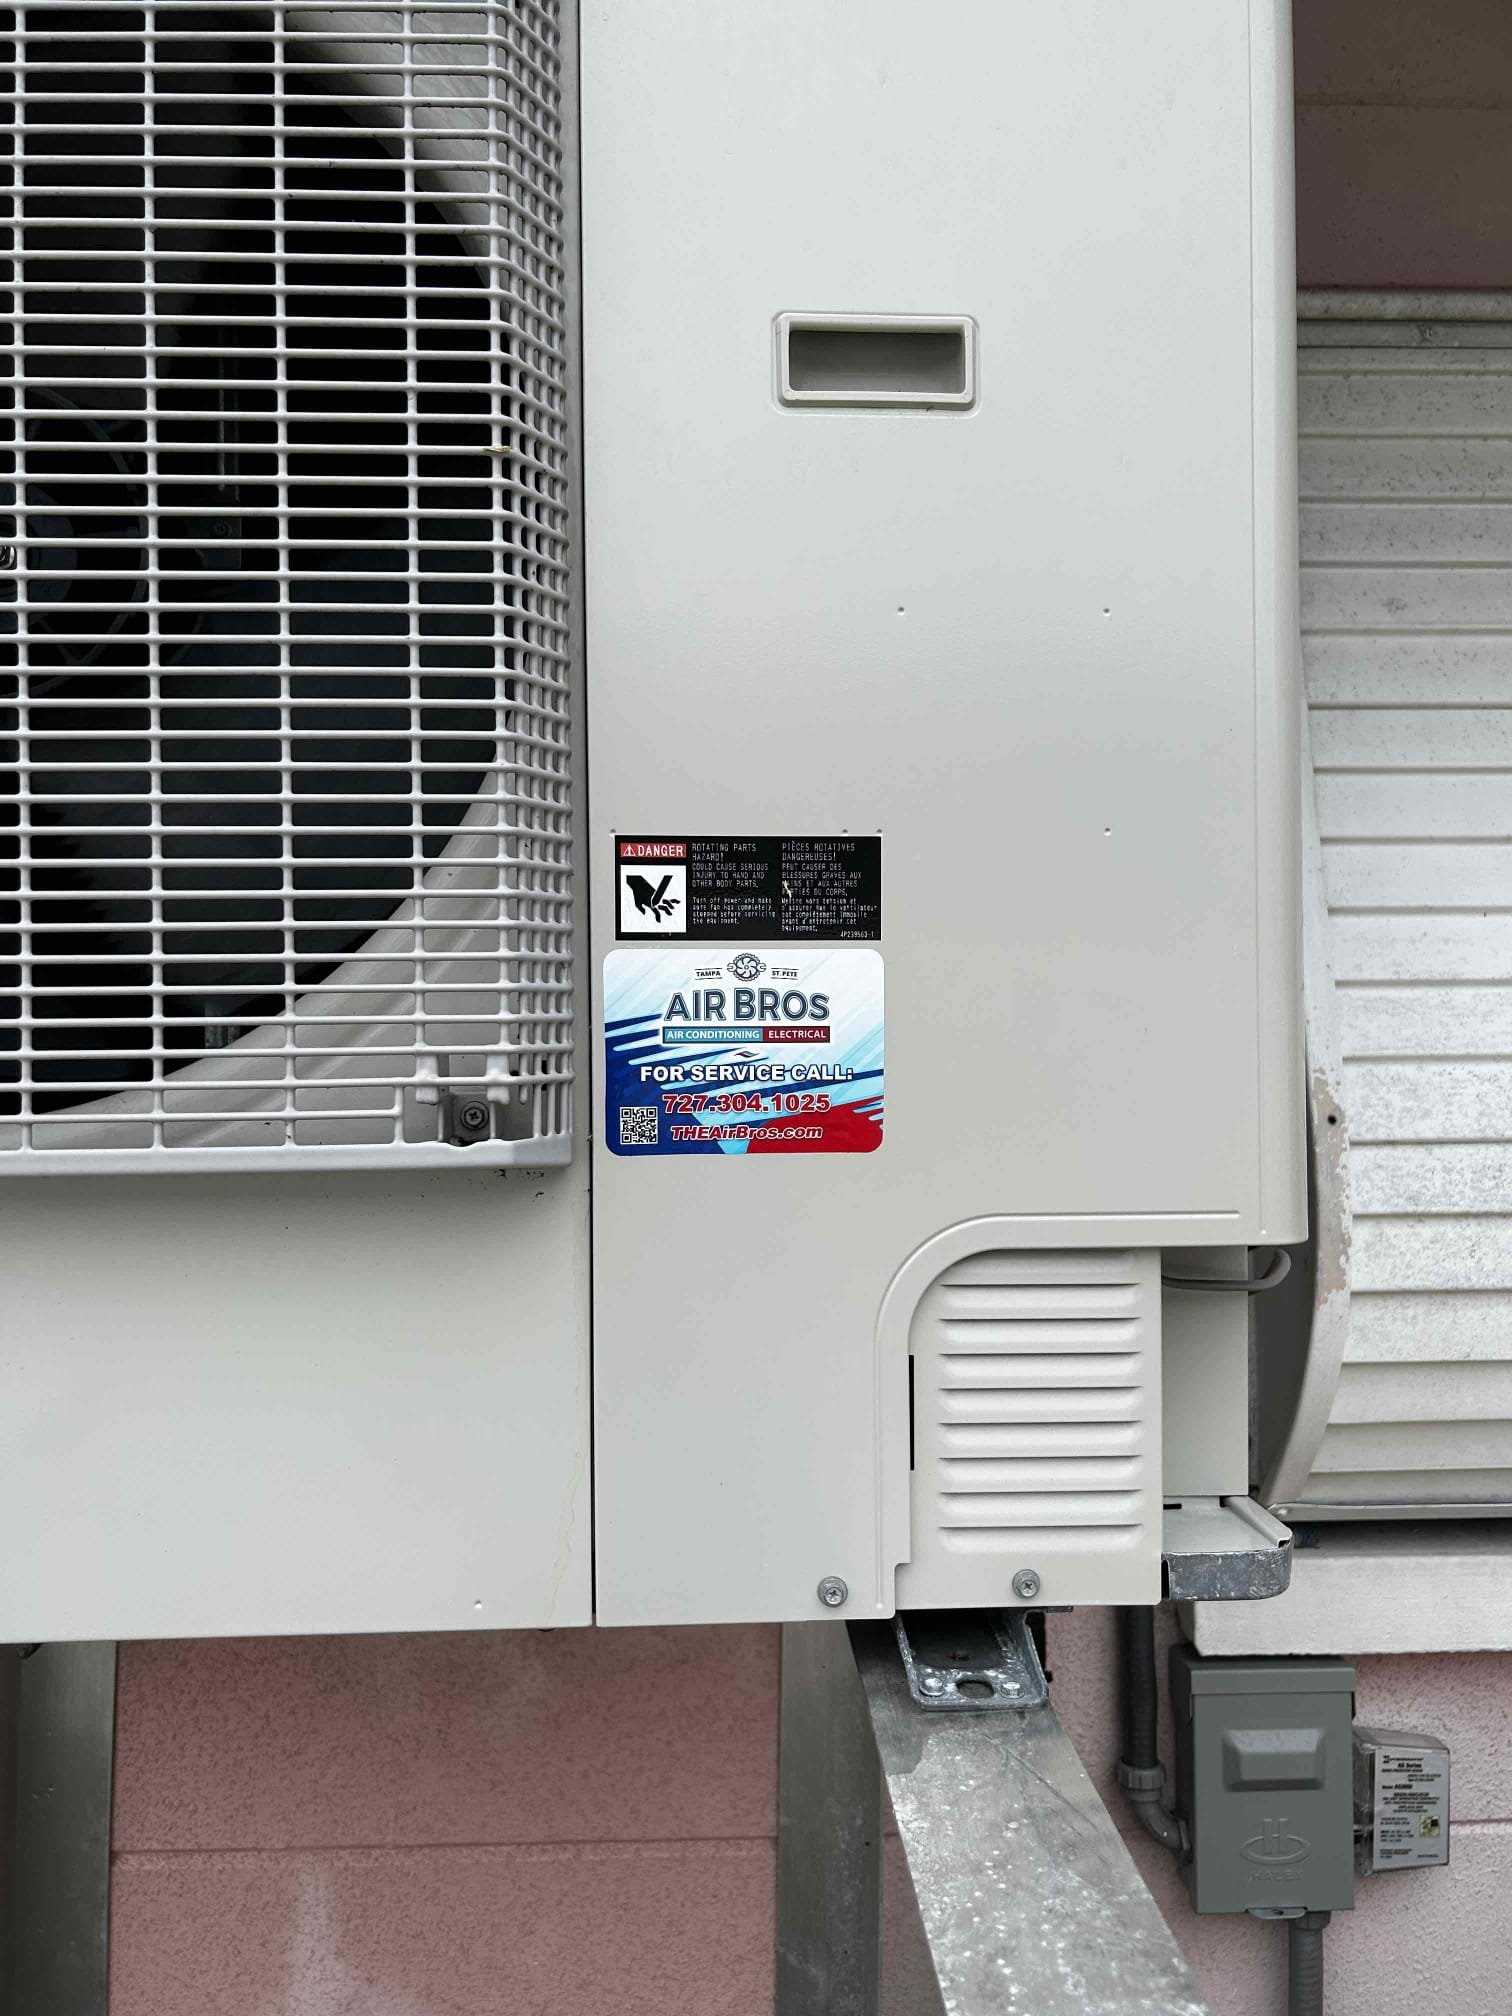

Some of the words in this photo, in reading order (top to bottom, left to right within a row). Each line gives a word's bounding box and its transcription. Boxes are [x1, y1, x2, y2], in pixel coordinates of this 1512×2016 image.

[638, 845, 683, 856] DANGER
[692, 843, 728, 852] ROTATING
[733, 843, 756, 852] PARTS
[782, 841, 809, 851] PIÈCES
[814, 843, 855, 851] ROTATIVES
[692, 853, 724, 861] HAZARD!
[782, 852, 836, 861] DANGEREUSES!
[664, 989, 726, 1022] AIR
[733, 988, 830, 1022] BROS
[667, 1030, 684, 1039] AIR
[686, 1030, 760, 1039] CONDITIONING
[768, 1030, 826, 1039] ELECTRICAL
[640, 1066, 685, 1082] FOR
[691, 1065, 786, 1082] SERVICE
[791, 1065, 853, 1082] CALL:
[662, 1094, 831, 1113] 727.304.1025
[671, 1125, 823, 1141] THEAirBros.com
